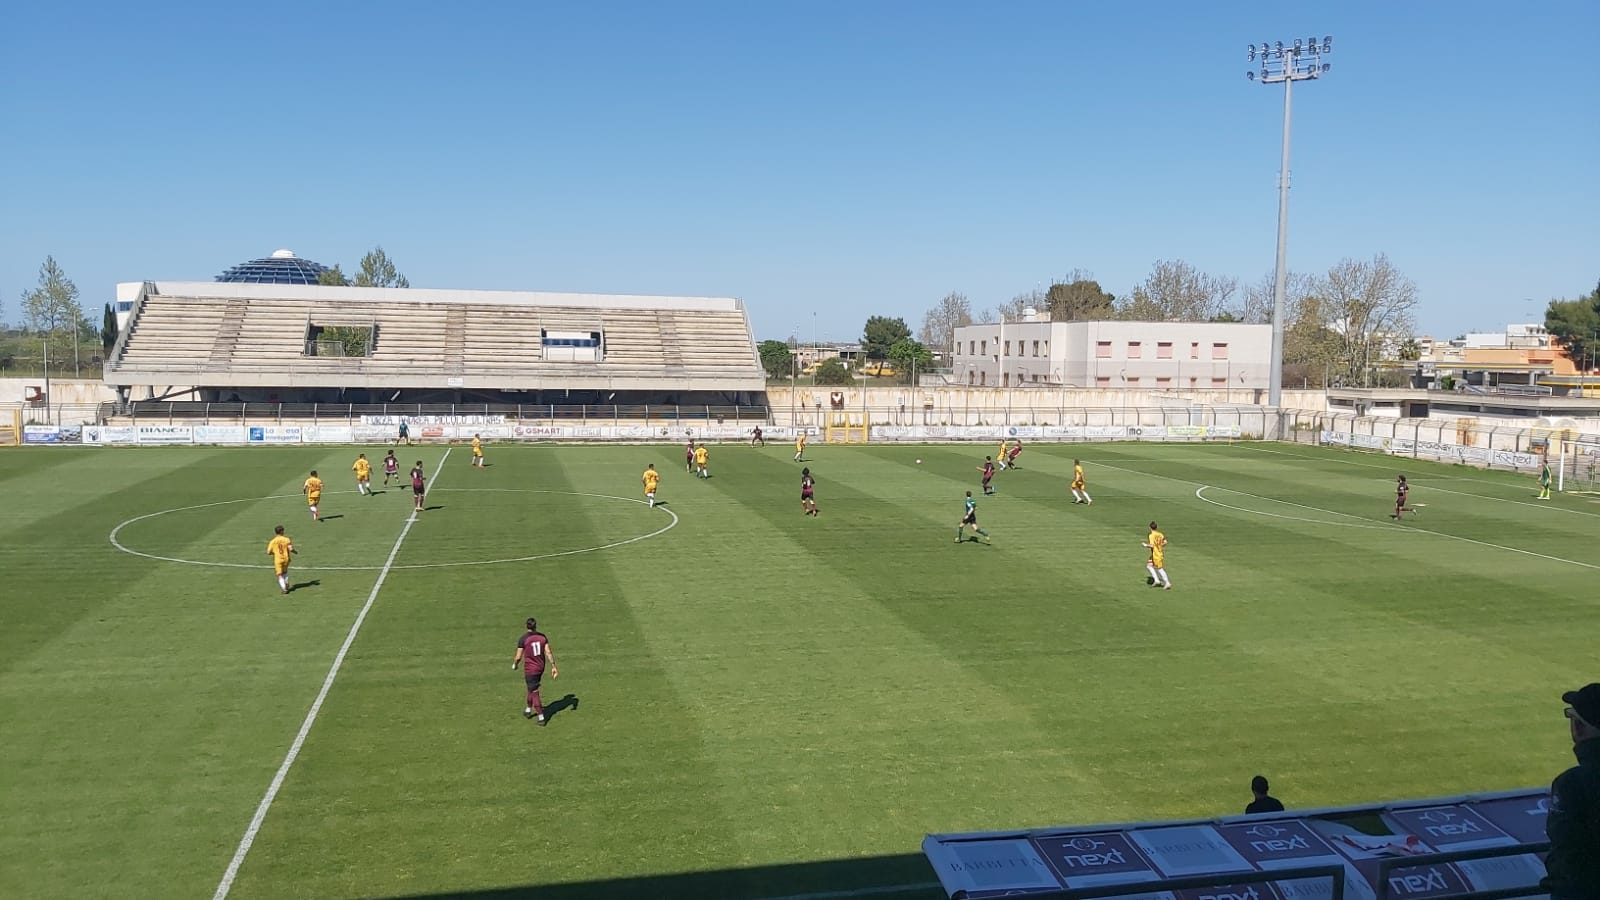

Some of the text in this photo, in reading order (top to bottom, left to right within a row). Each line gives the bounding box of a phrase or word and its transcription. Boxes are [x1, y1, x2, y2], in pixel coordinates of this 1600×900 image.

[525, 427, 561, 435] GSMART
[531, 641, 541, 656] 11
[1424, 818, 1483, 837] next
[1250, 834, 1310, 852] next
[950, 857, 1044, 872] BARBETTA
[1064, 848, 1127, 867] next
[1388, 866, 1449, 895] next
